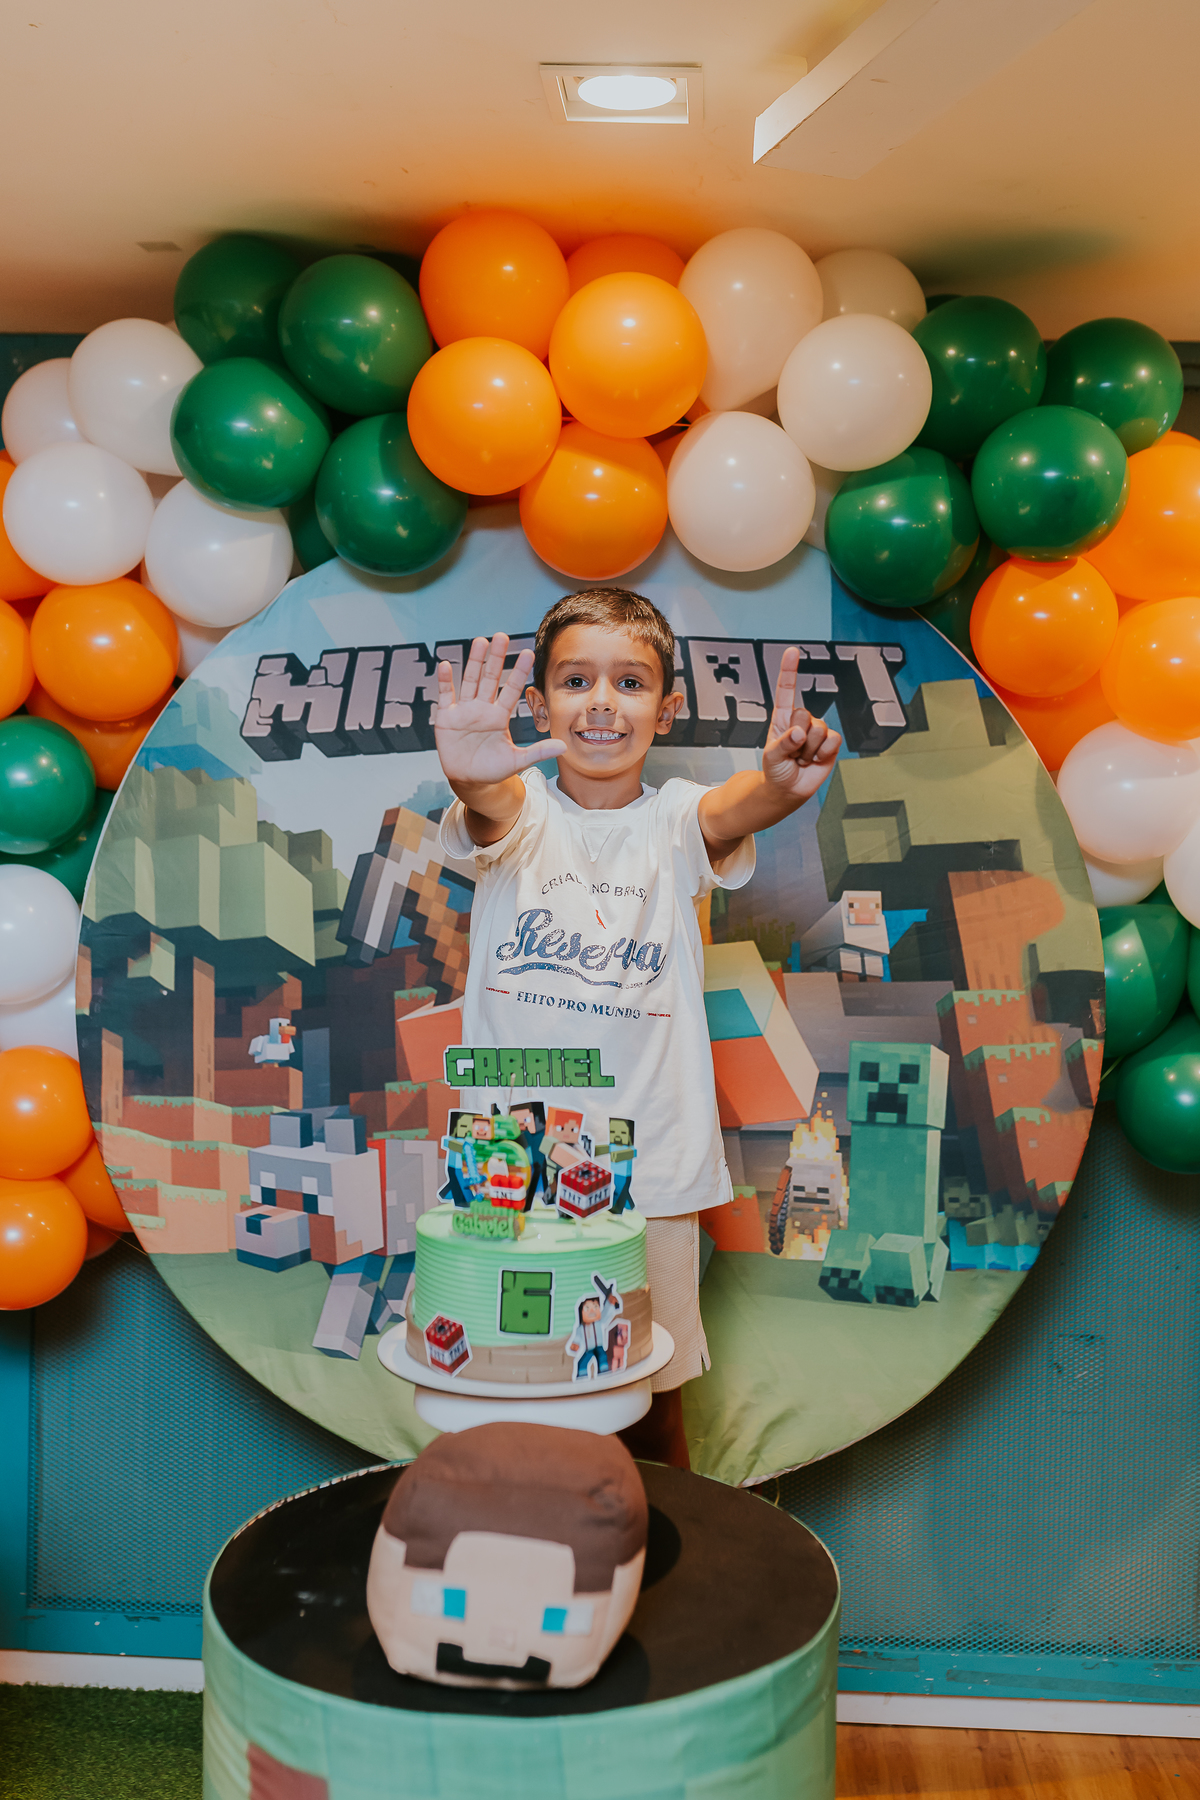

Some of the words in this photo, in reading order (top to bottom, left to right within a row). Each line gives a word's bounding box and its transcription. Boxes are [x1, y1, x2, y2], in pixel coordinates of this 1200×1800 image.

[240, 629, 907, 762] MINAFT
[541, 872, 588, 895] CRIA
[591, 882, 610, 894] NO
[516, 990, 556, 1007] FEITO
[557, 997, 587, 1013] PRO
[590, 1003, 641, 1020] MUNDO
[445, 1047, 616, 1088] GABRIEL
[493, 1190, 513, 1201] TNT
[562, 1188, 583, 1206] TNT
[588, 1187, 609, 1207] TNT
[452, 1213, 515, 1239] Gabriel
[500, 1269, 553, 1335] 6
